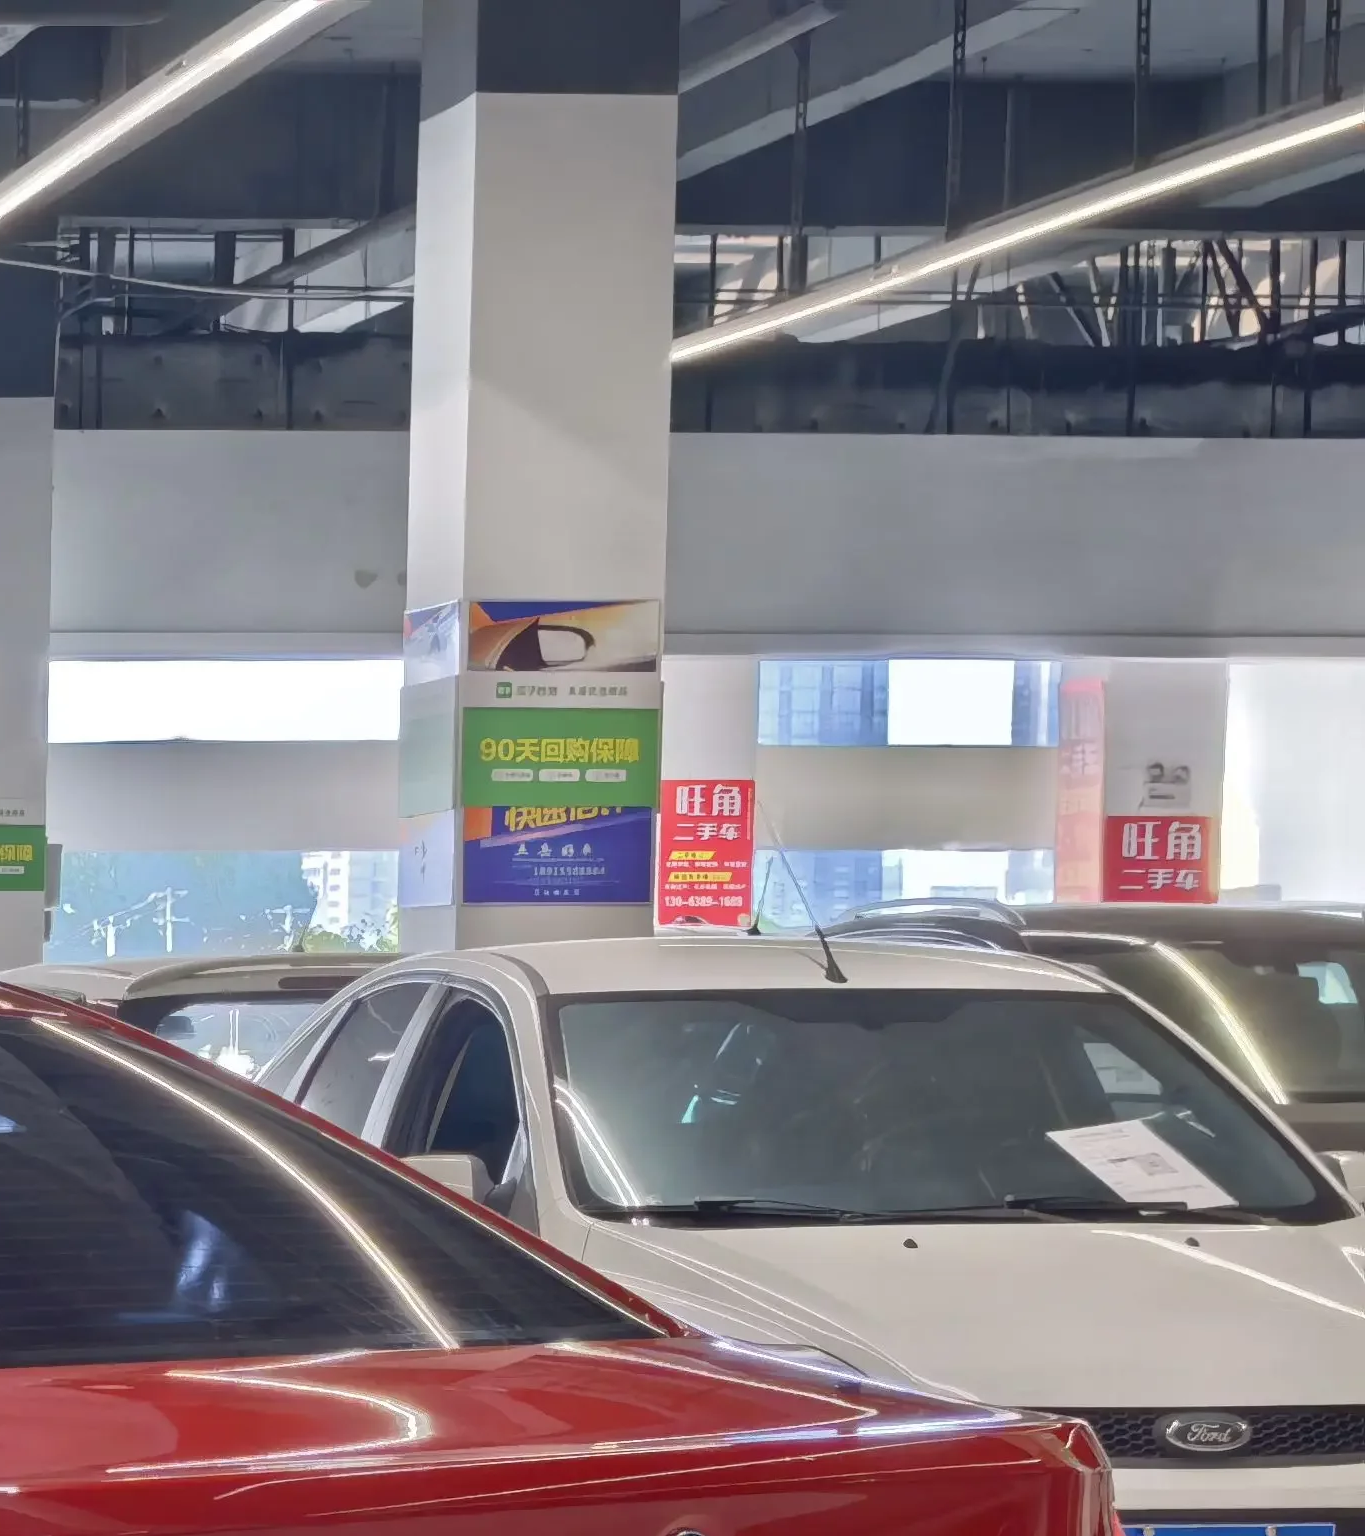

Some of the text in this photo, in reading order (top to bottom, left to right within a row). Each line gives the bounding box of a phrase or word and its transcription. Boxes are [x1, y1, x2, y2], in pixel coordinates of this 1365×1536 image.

[480, 738, 640, 764] 90天回购保障
[675, 784, 742, 817] 旺角
[672, 823, 741, 841] 二手车
[1121, 821, 1202, 861] 旺角
[1119, 868, 1203, 890] 二手车
[1186, 1423, 1233, 1443] Ford
